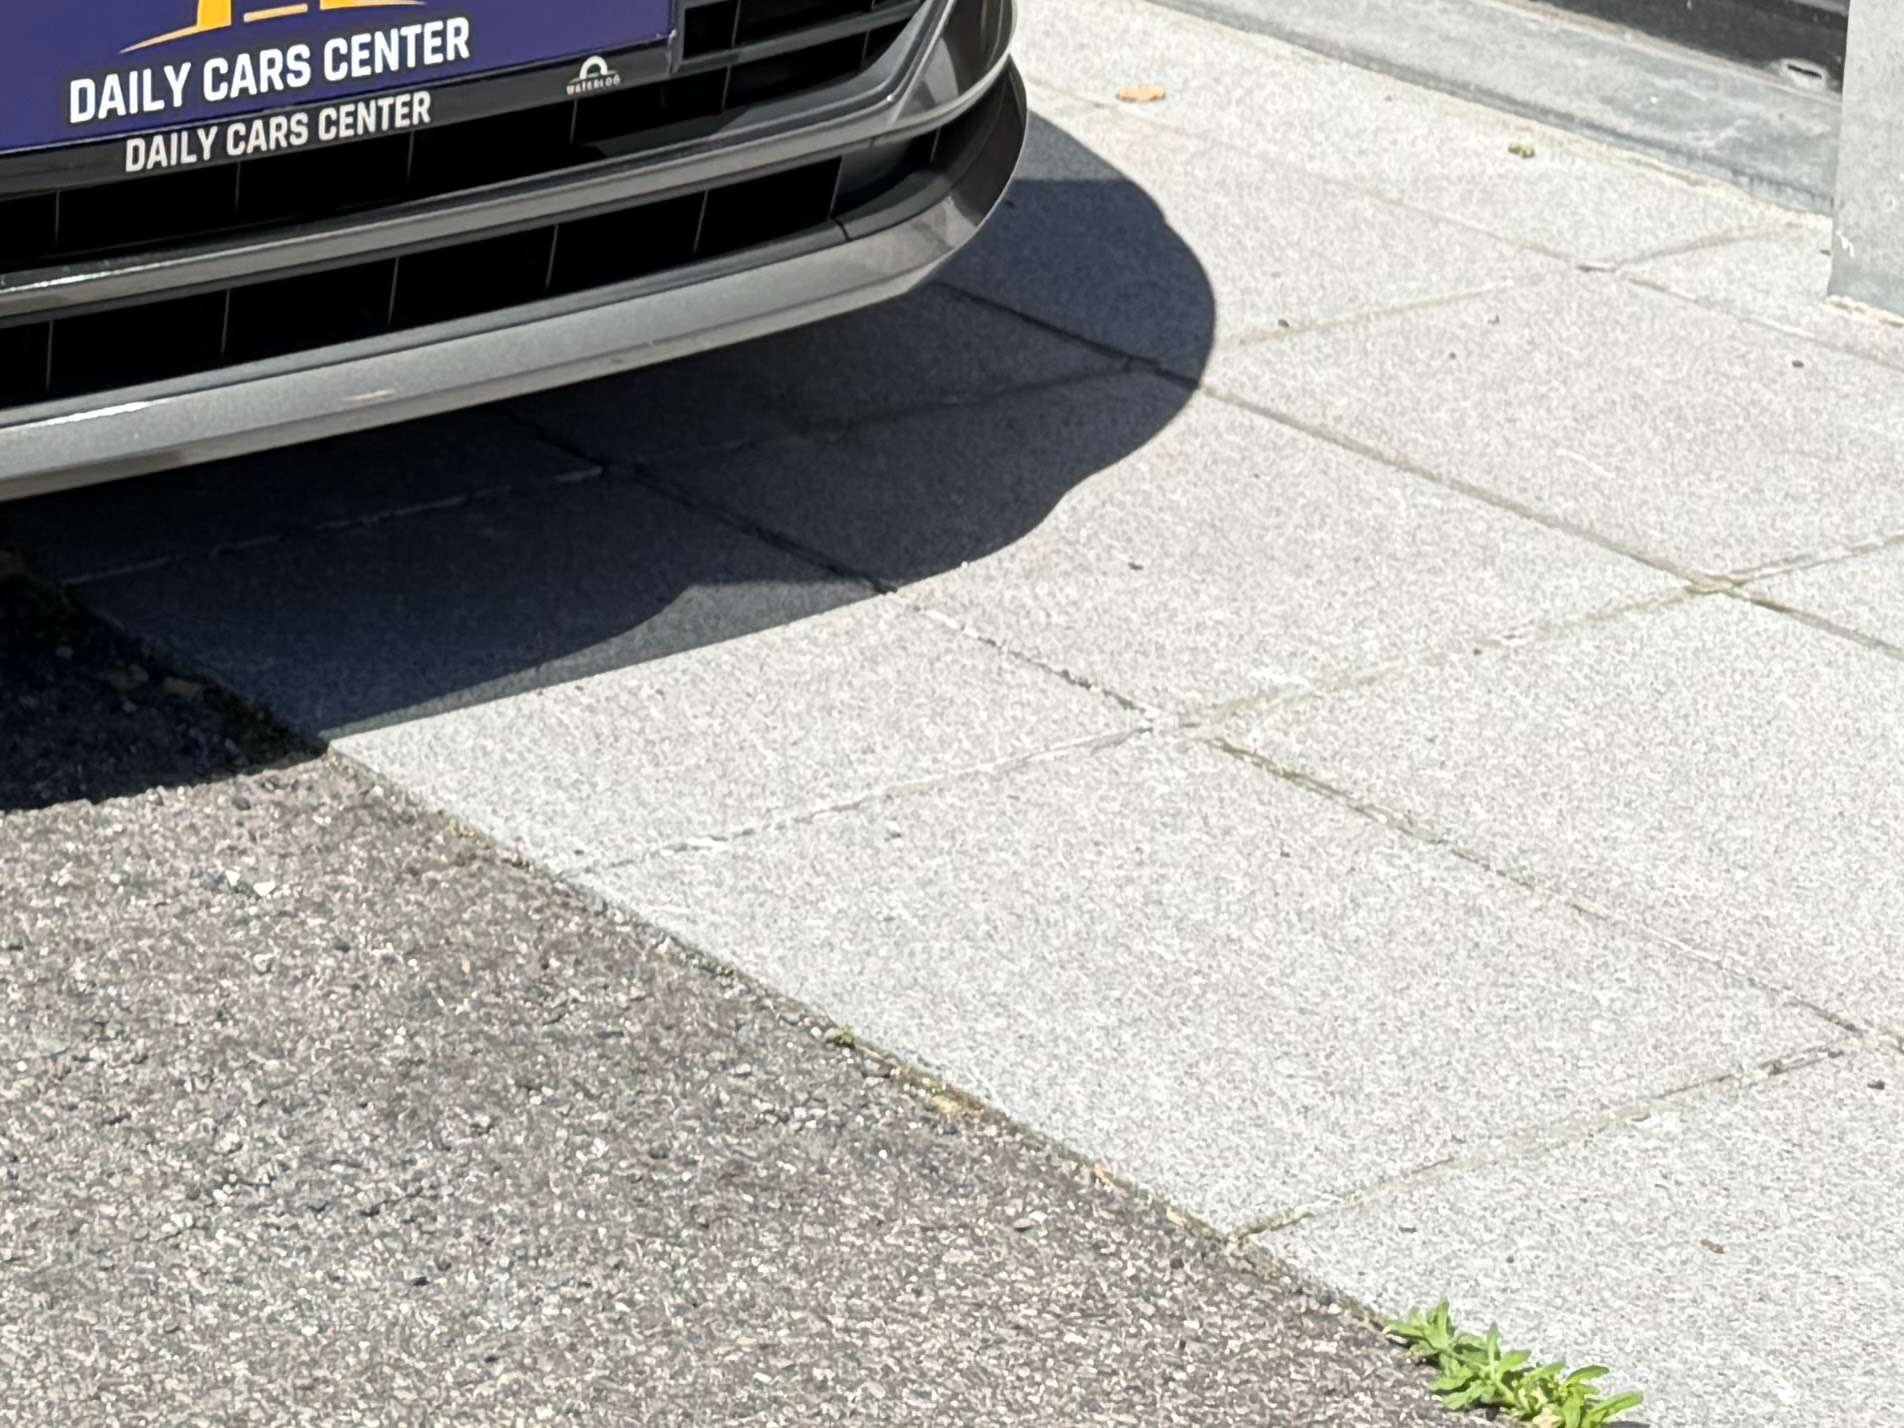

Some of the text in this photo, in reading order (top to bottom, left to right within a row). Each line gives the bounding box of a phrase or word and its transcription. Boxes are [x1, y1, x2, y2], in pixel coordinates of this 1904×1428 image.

[69, 16, 471, 124] DAILY CARS CENTER
[125, 90, 432, 173] DAILY CARS CENTER
